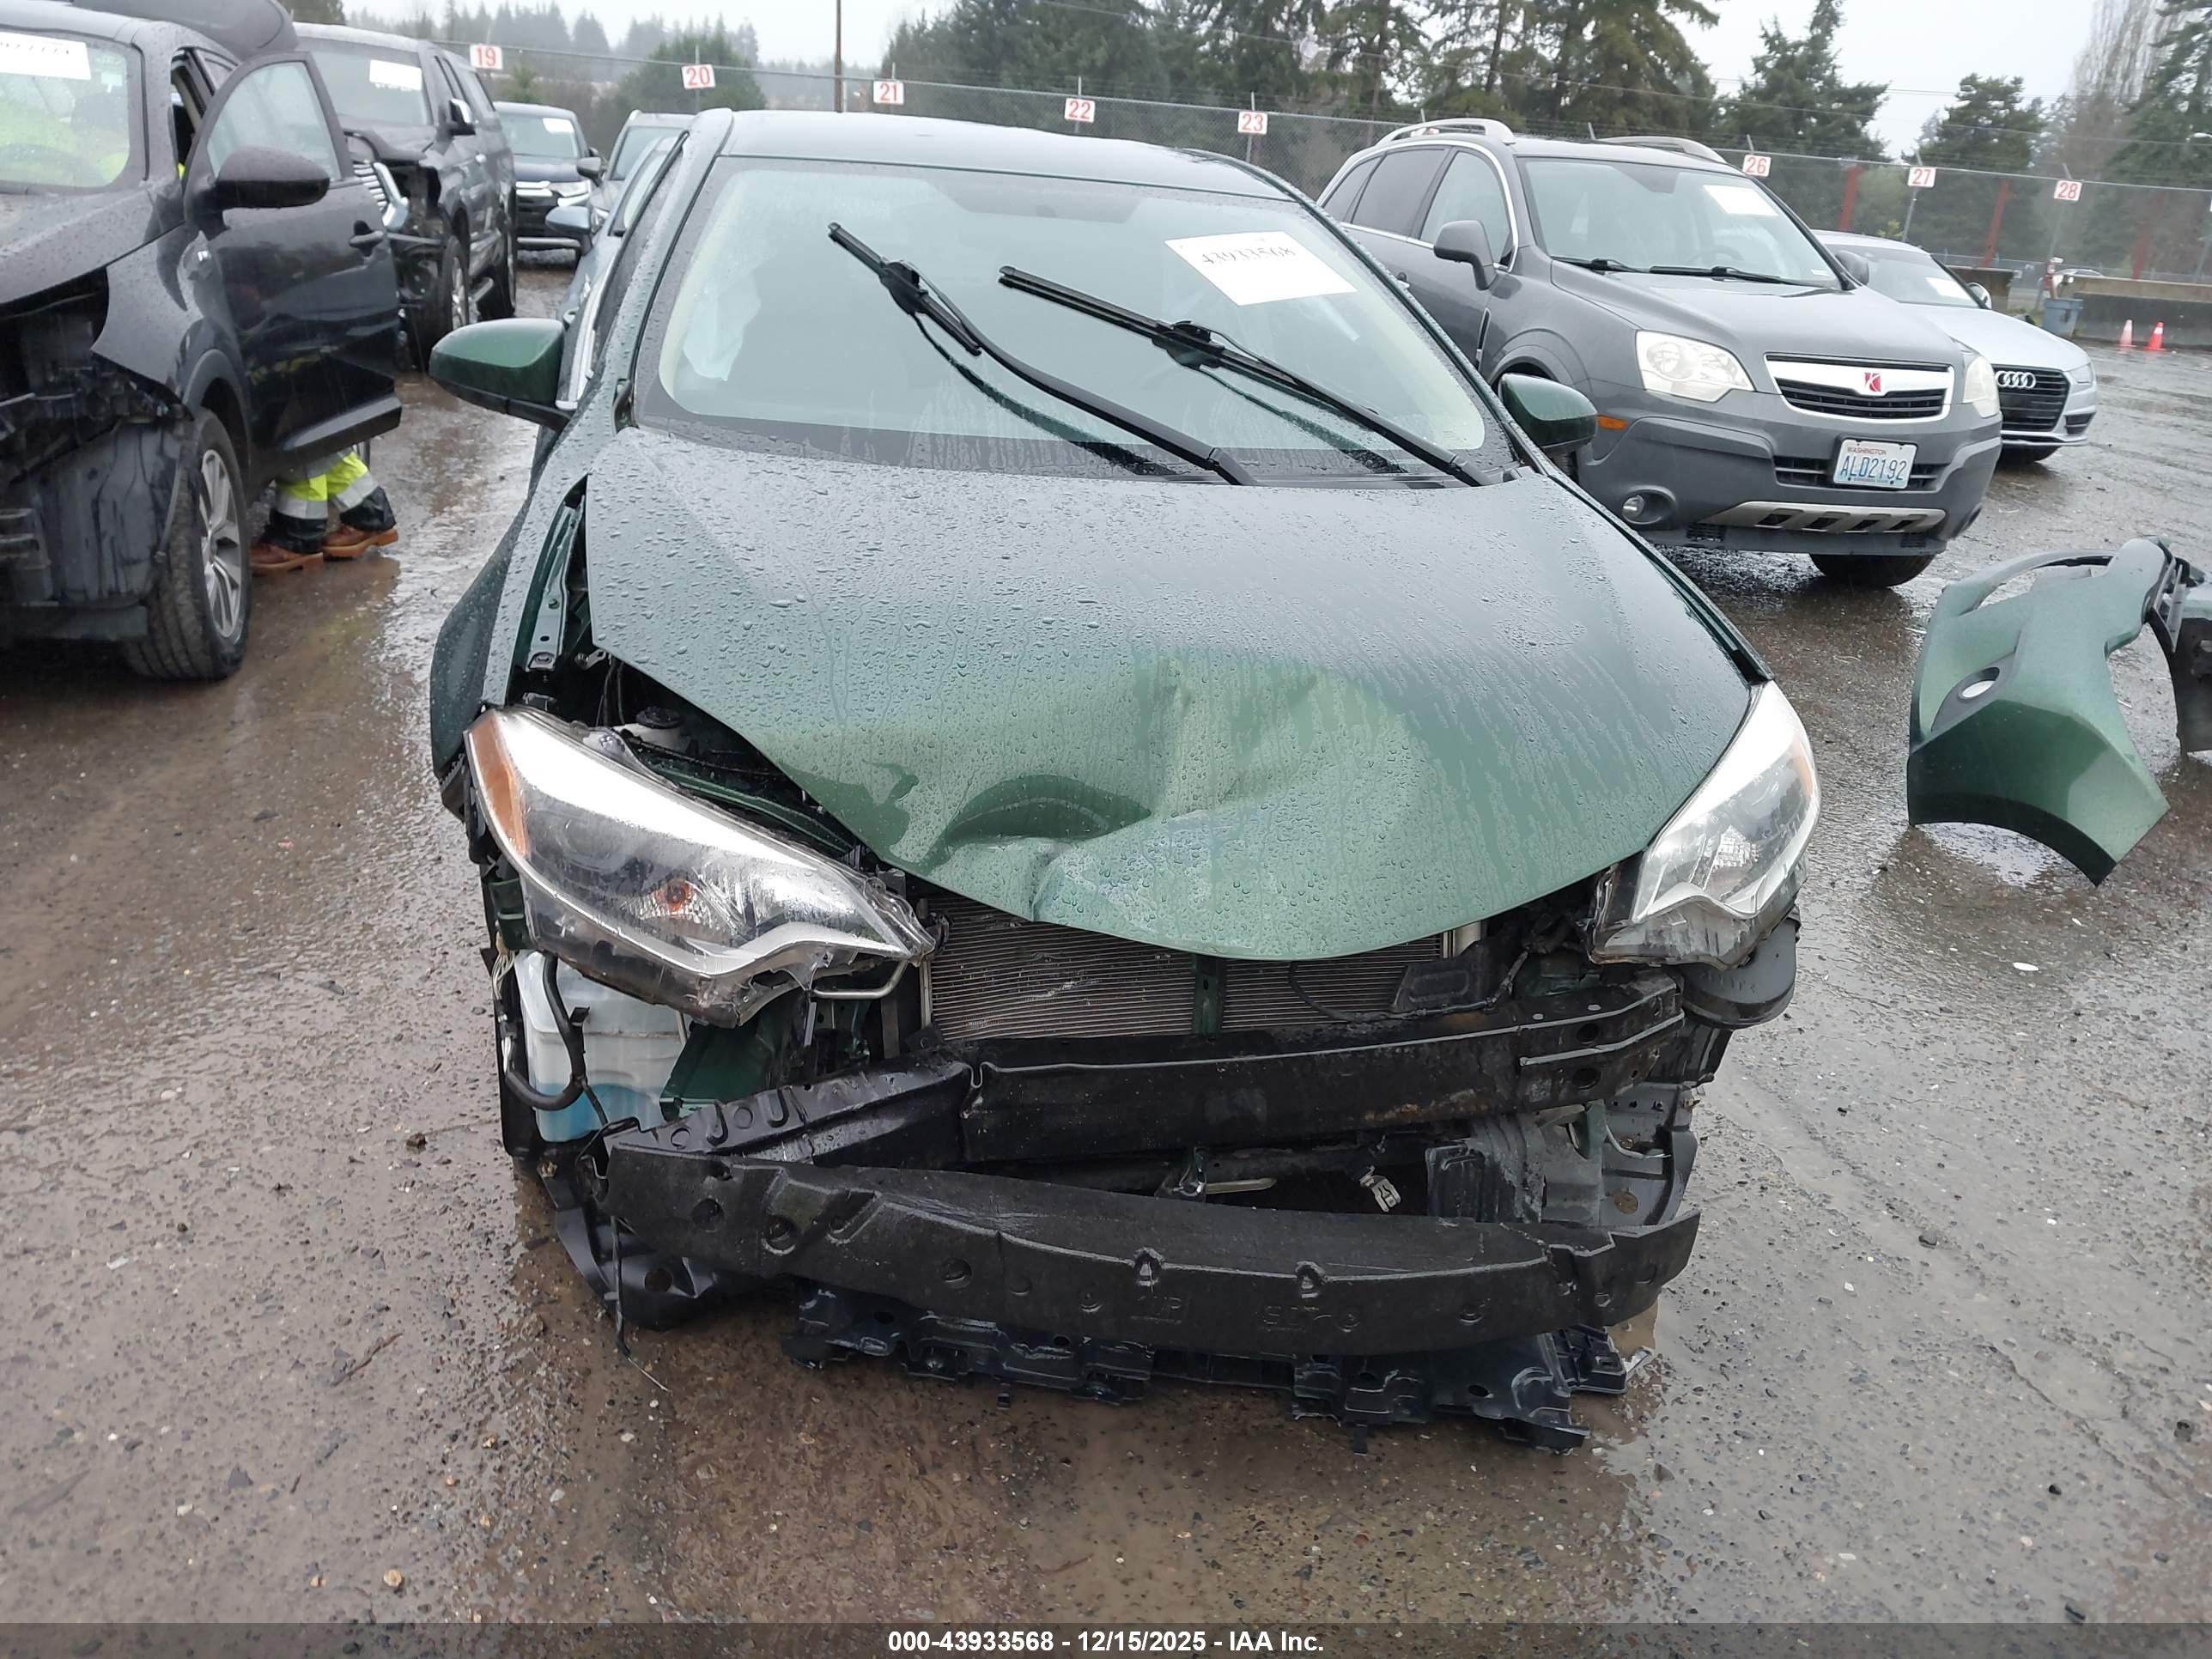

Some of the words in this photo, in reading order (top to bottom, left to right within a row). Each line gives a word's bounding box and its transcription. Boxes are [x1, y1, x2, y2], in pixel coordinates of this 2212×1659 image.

[474, 46, 496, 68] 19
[685, 66, 711, 86] 20
[879, 82, 898, 101] 21
[1067, 100, 1092, 119] 22
[1241, 113, 1264, 131] 23
[1746, 156, 1768, 174] 26
[1911, 167, 1932, 185] 27
[2057, 182, 2079, 199] 28
